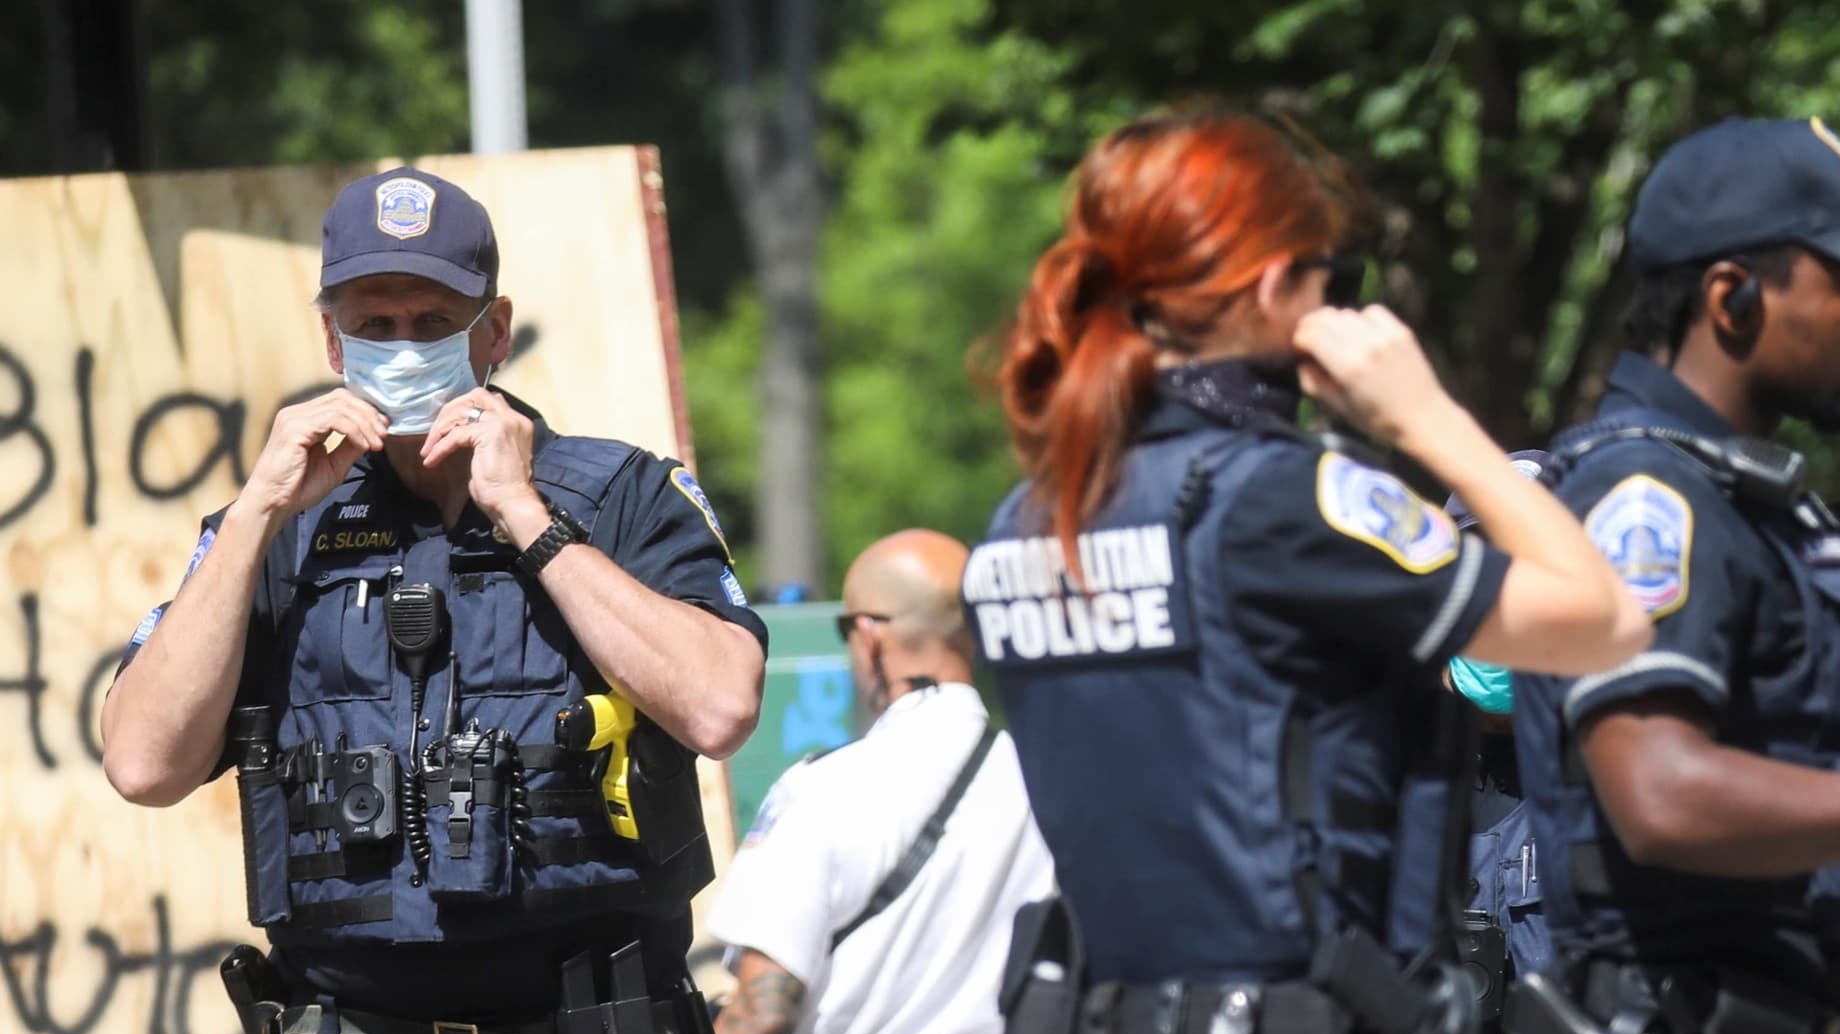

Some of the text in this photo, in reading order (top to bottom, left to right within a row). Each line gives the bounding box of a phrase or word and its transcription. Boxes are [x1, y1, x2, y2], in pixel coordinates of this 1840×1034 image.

[338, 504, 370, 519] POLICE
[315, 533, 329, 551] C.
[963, 525, 1174, 604] METROPLITAN
[977, 588, 1175, 660] POLICE
